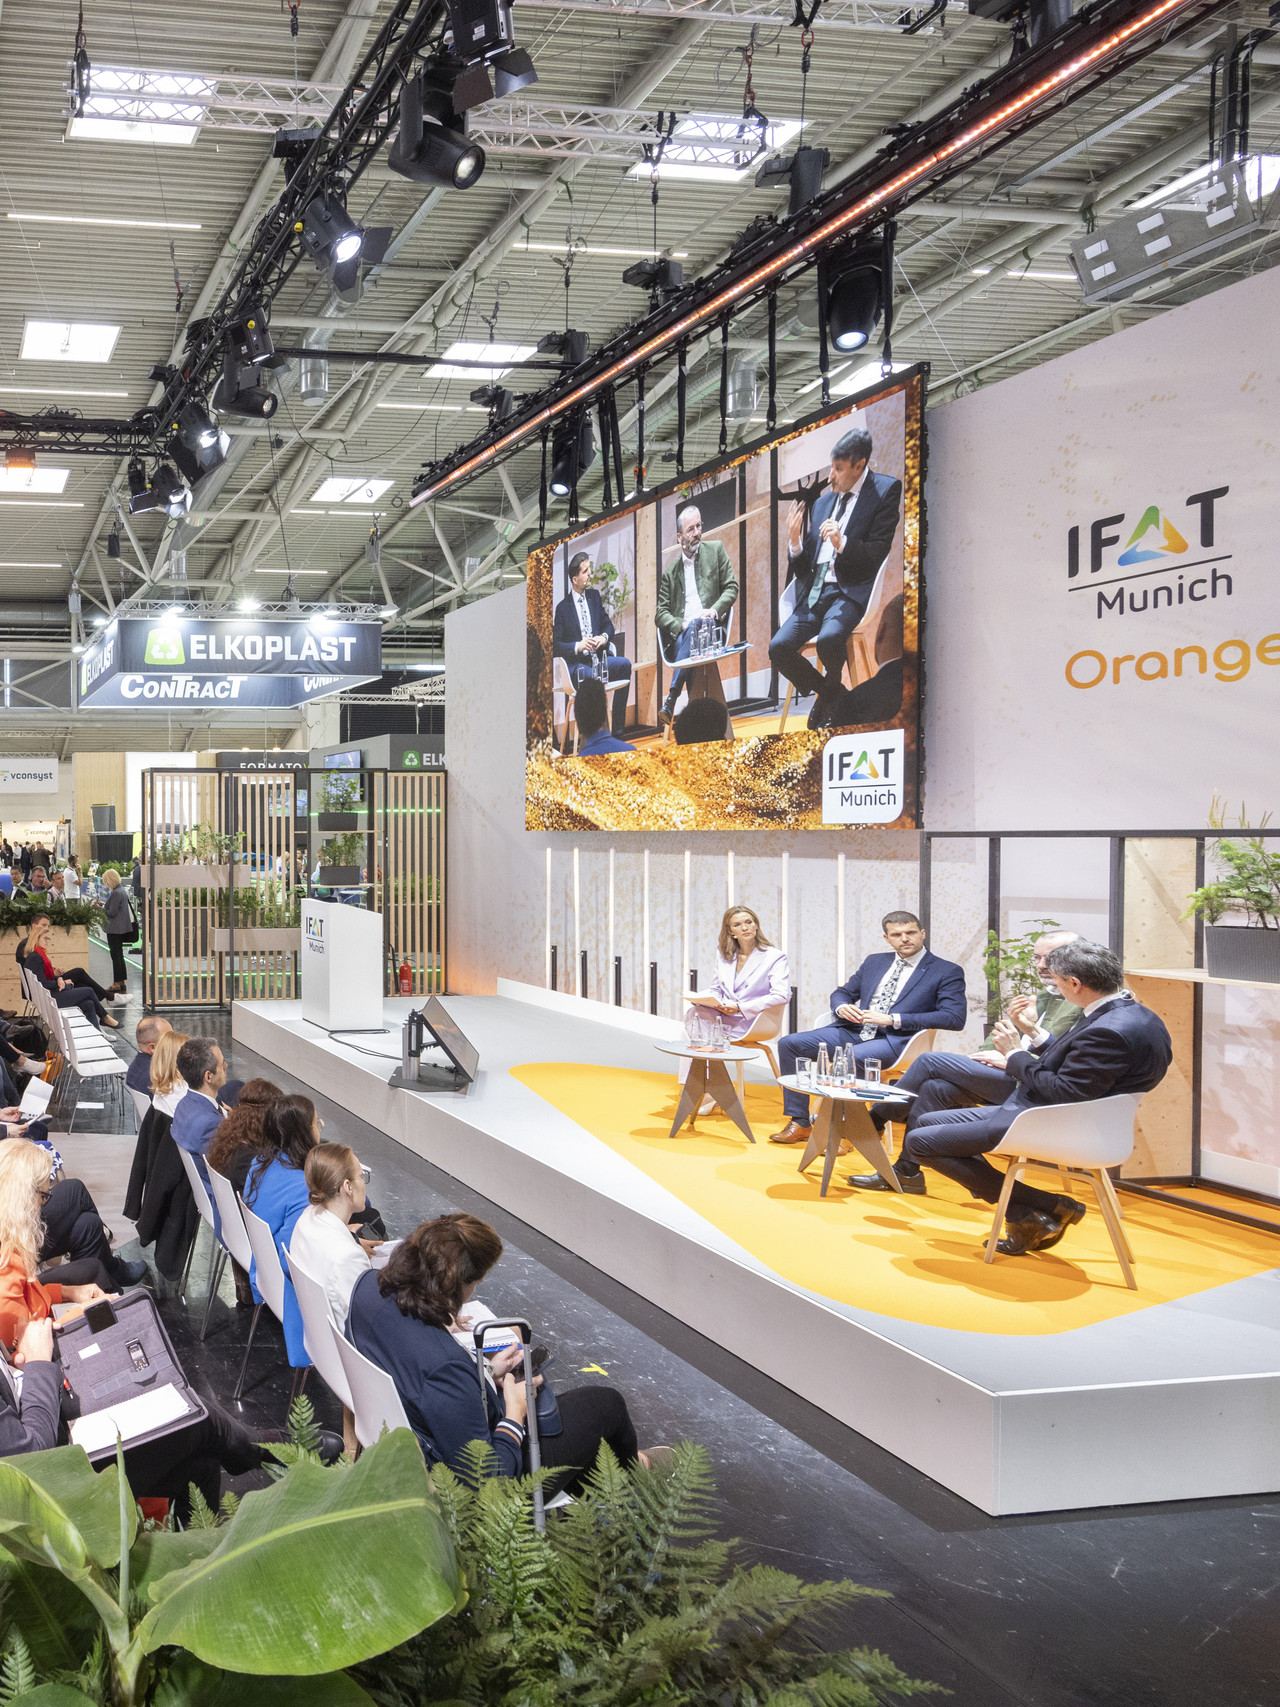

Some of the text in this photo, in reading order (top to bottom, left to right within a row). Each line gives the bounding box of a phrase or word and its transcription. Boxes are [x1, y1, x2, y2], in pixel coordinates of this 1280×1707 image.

[1066, 485, 1231, 579] IFAT
[1095, 567, 1233, 619] Munich
[189, 634, 357, 662] ELKOPLAST
[1065, 632, 1280, 690] Orange
[10, 771, 53, 782] vconsyst
[828, 747, 897, 783] IFAT
[840, 788, 897, 808] Munich
[305, 916, 324, 938] IFAT
[308, 941, 325, 955] Munich
